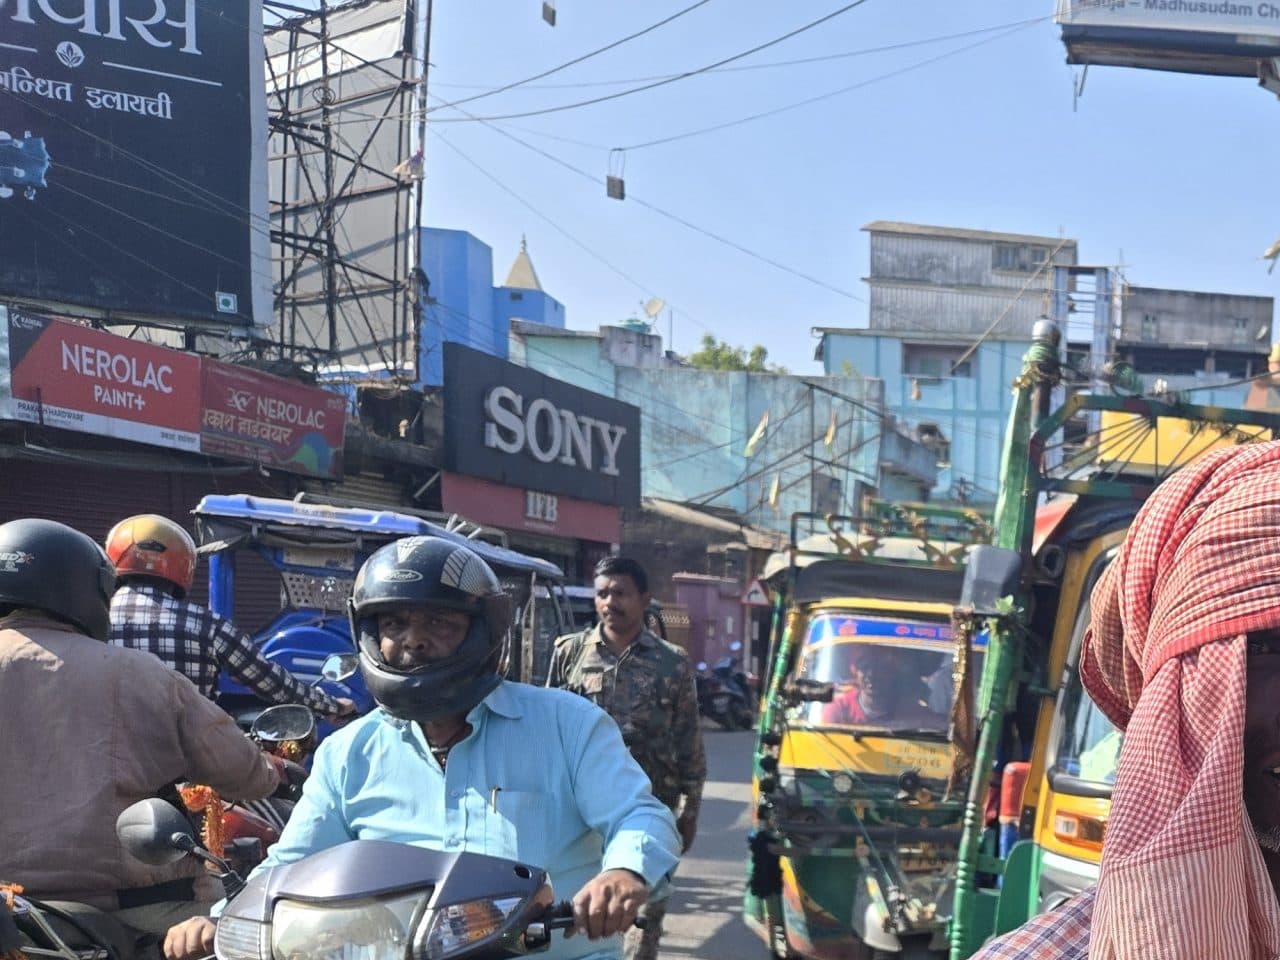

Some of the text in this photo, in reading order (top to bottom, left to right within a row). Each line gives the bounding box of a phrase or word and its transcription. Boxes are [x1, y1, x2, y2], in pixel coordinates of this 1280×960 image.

[1144, 0, 1253, 17] Madhusudam
[84, 86, 174, 119] इलायची
[61, 340, 173, 394] NEROLAC
[94, 384, 146, 411] PAINT+
[256, 396, 326, 430] NEROLAC
[485, 386, 627, 476] SONY
[526, 490, 558, 522] IFB
